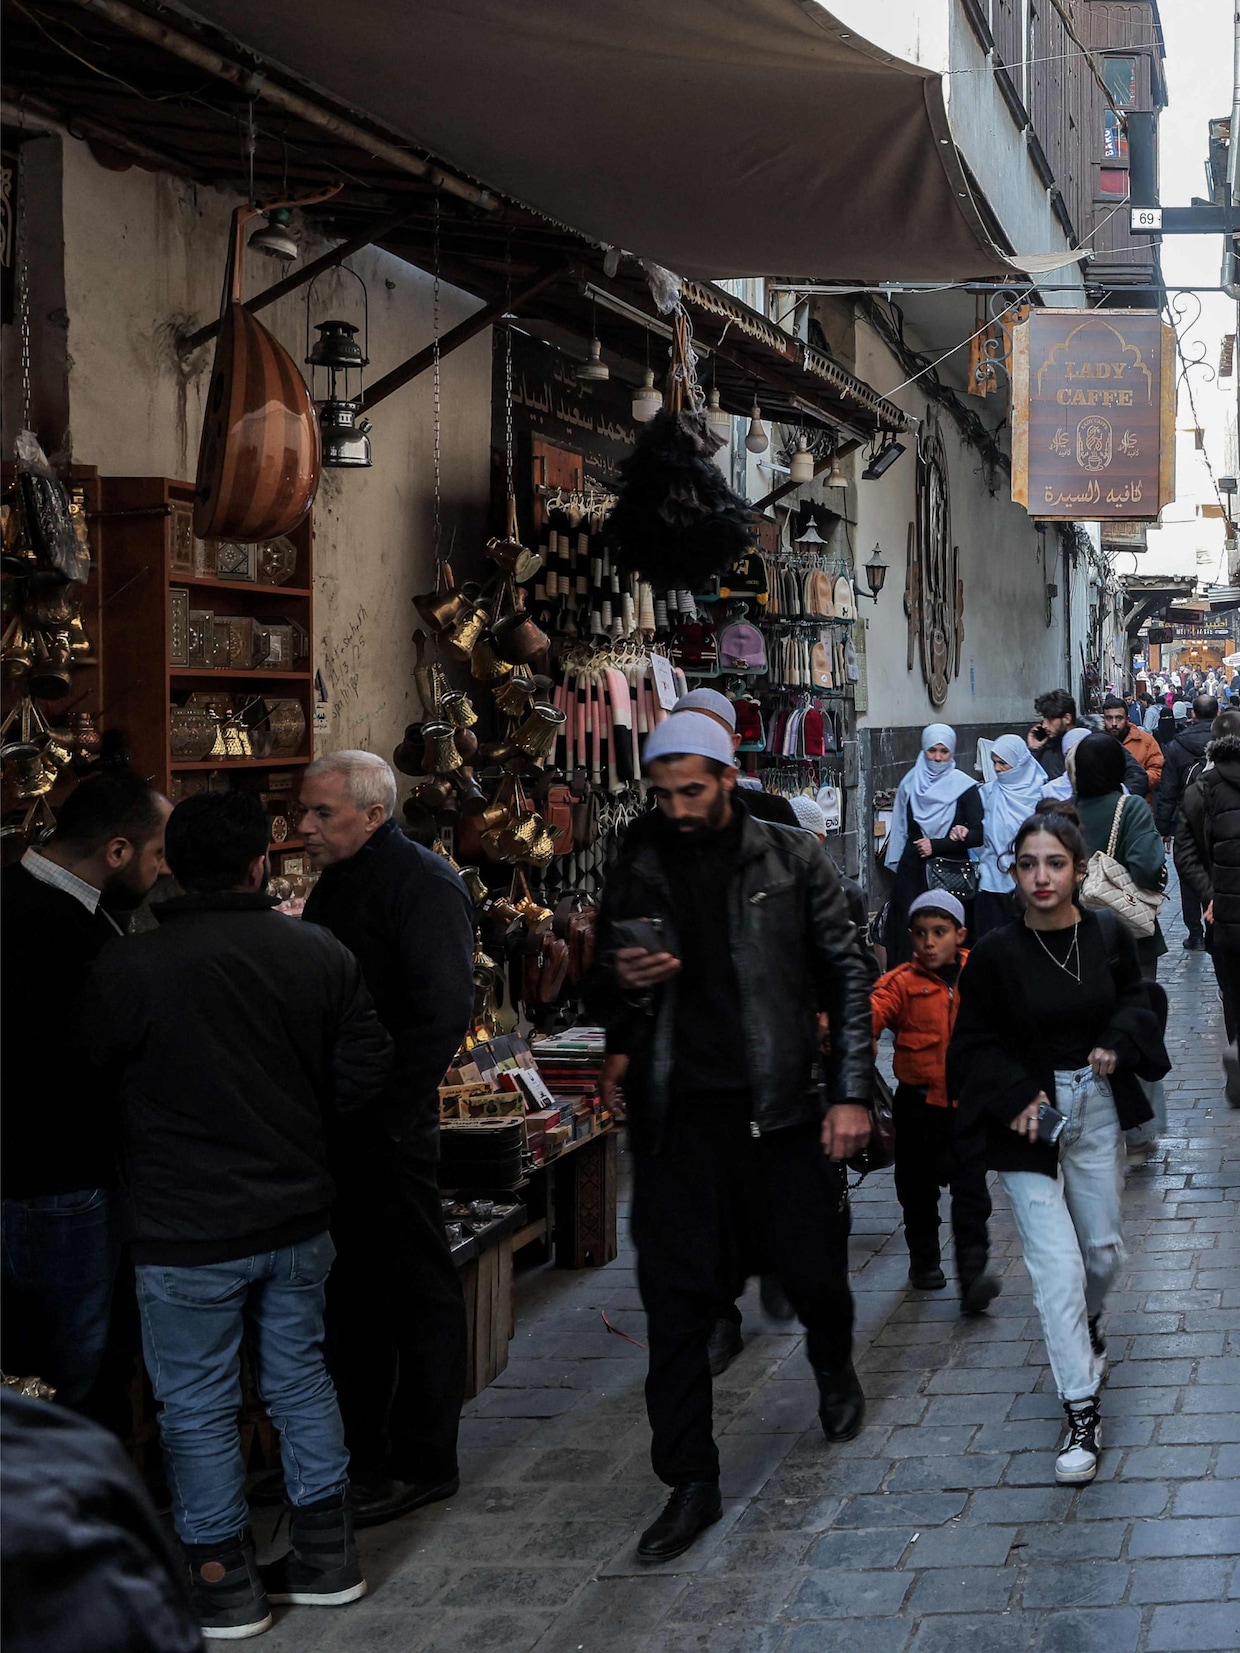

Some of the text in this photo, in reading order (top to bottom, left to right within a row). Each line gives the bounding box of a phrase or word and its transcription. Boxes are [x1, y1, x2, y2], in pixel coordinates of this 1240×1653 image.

[1139, 212, 1154, 225] 69
[1064, 361, 1127, 379] LADY
[1056, 388, 1133, 407] CAFFE
[556, 397, 594, 436] سعيد
[597, 413, 636, 445] محمد
[1044, 479, 1143, 508] كافيه السيرة
